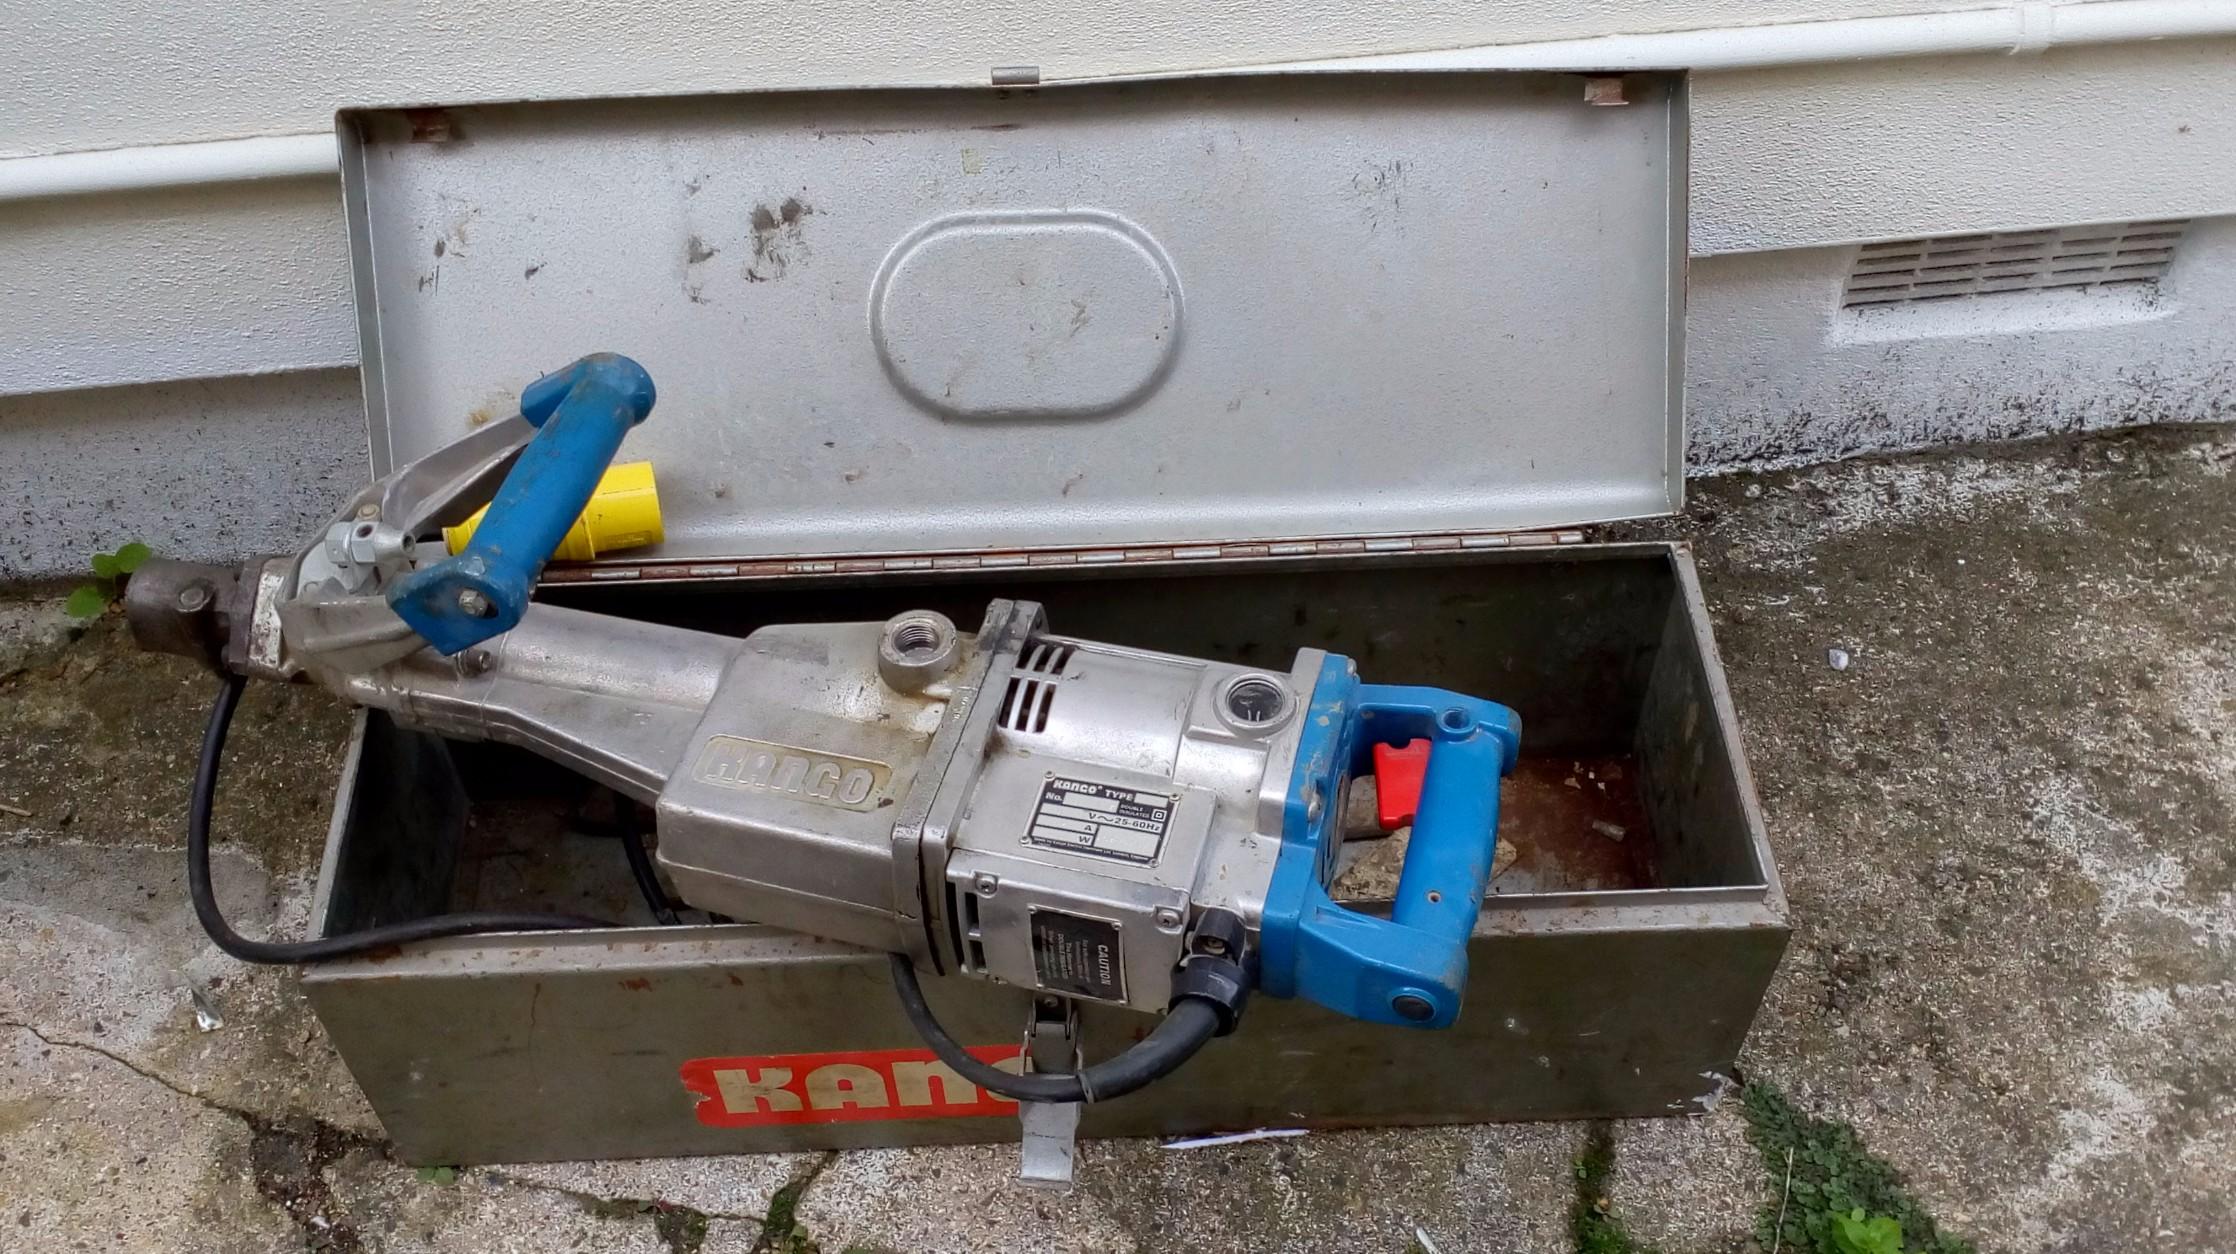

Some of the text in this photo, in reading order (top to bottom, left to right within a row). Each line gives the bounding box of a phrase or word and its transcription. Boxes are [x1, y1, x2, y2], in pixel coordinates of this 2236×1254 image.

[1044, 791, 1063, 802] No.
[1105, 789, 1134, 801] TYPE
[1083, 824, 1092, 832] A
[1078, 835, 1091, 843] W
[1097, 944, 1111, 985] CAUTION
